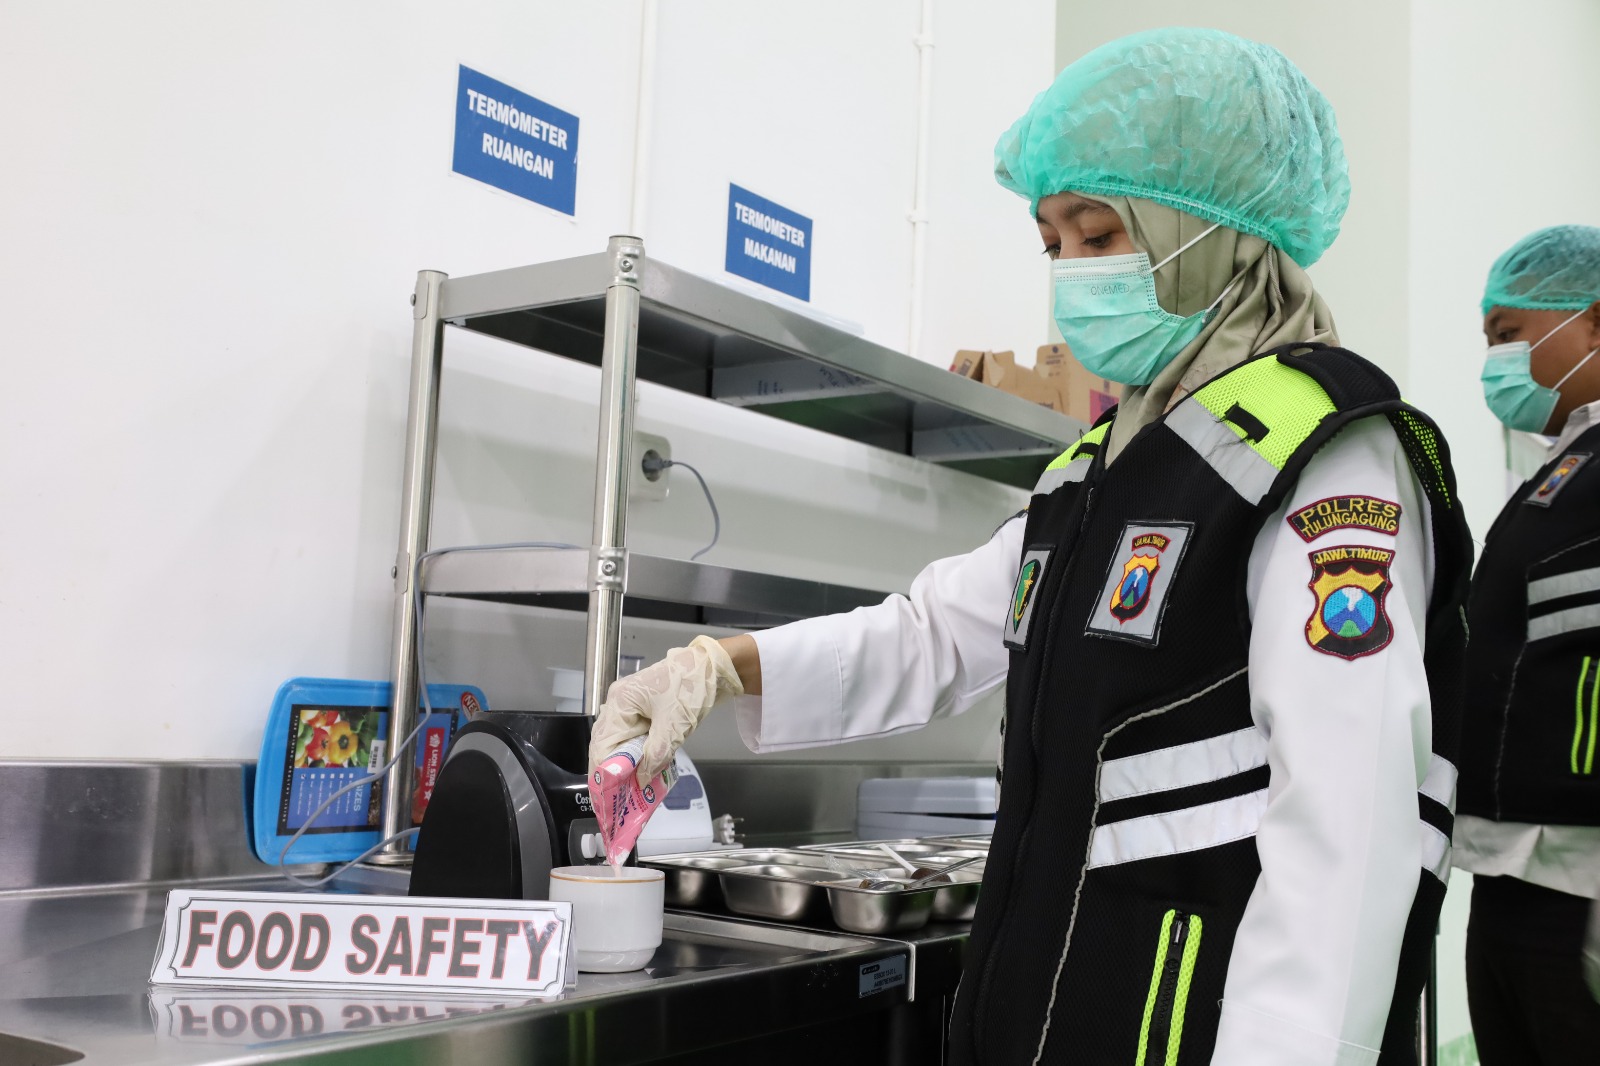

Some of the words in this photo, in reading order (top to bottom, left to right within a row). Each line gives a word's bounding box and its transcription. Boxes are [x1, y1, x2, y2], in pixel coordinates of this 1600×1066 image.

[467, 88, 568, 151] TERMOMETER
[482, 132, 554, 180] RUANGAN
[734, 201, 805, 248] TERMOMETER
[744, 237, 796, 274] MAKANAN
[1090, 283, 1130, 296] ONEMED
[1300, 497, 1399, 525] POLRES
[1301, 512, 1397, 538] TULUNGAGUNG
[1315, 548, 1348, 564] JAWA
[1349, 548, 1389, 562] TIMUR
[428, 768, 437, 787] STAR
[180, 910, 331, 973] FOOD
[345, 913, 560, 982] SAFETY
